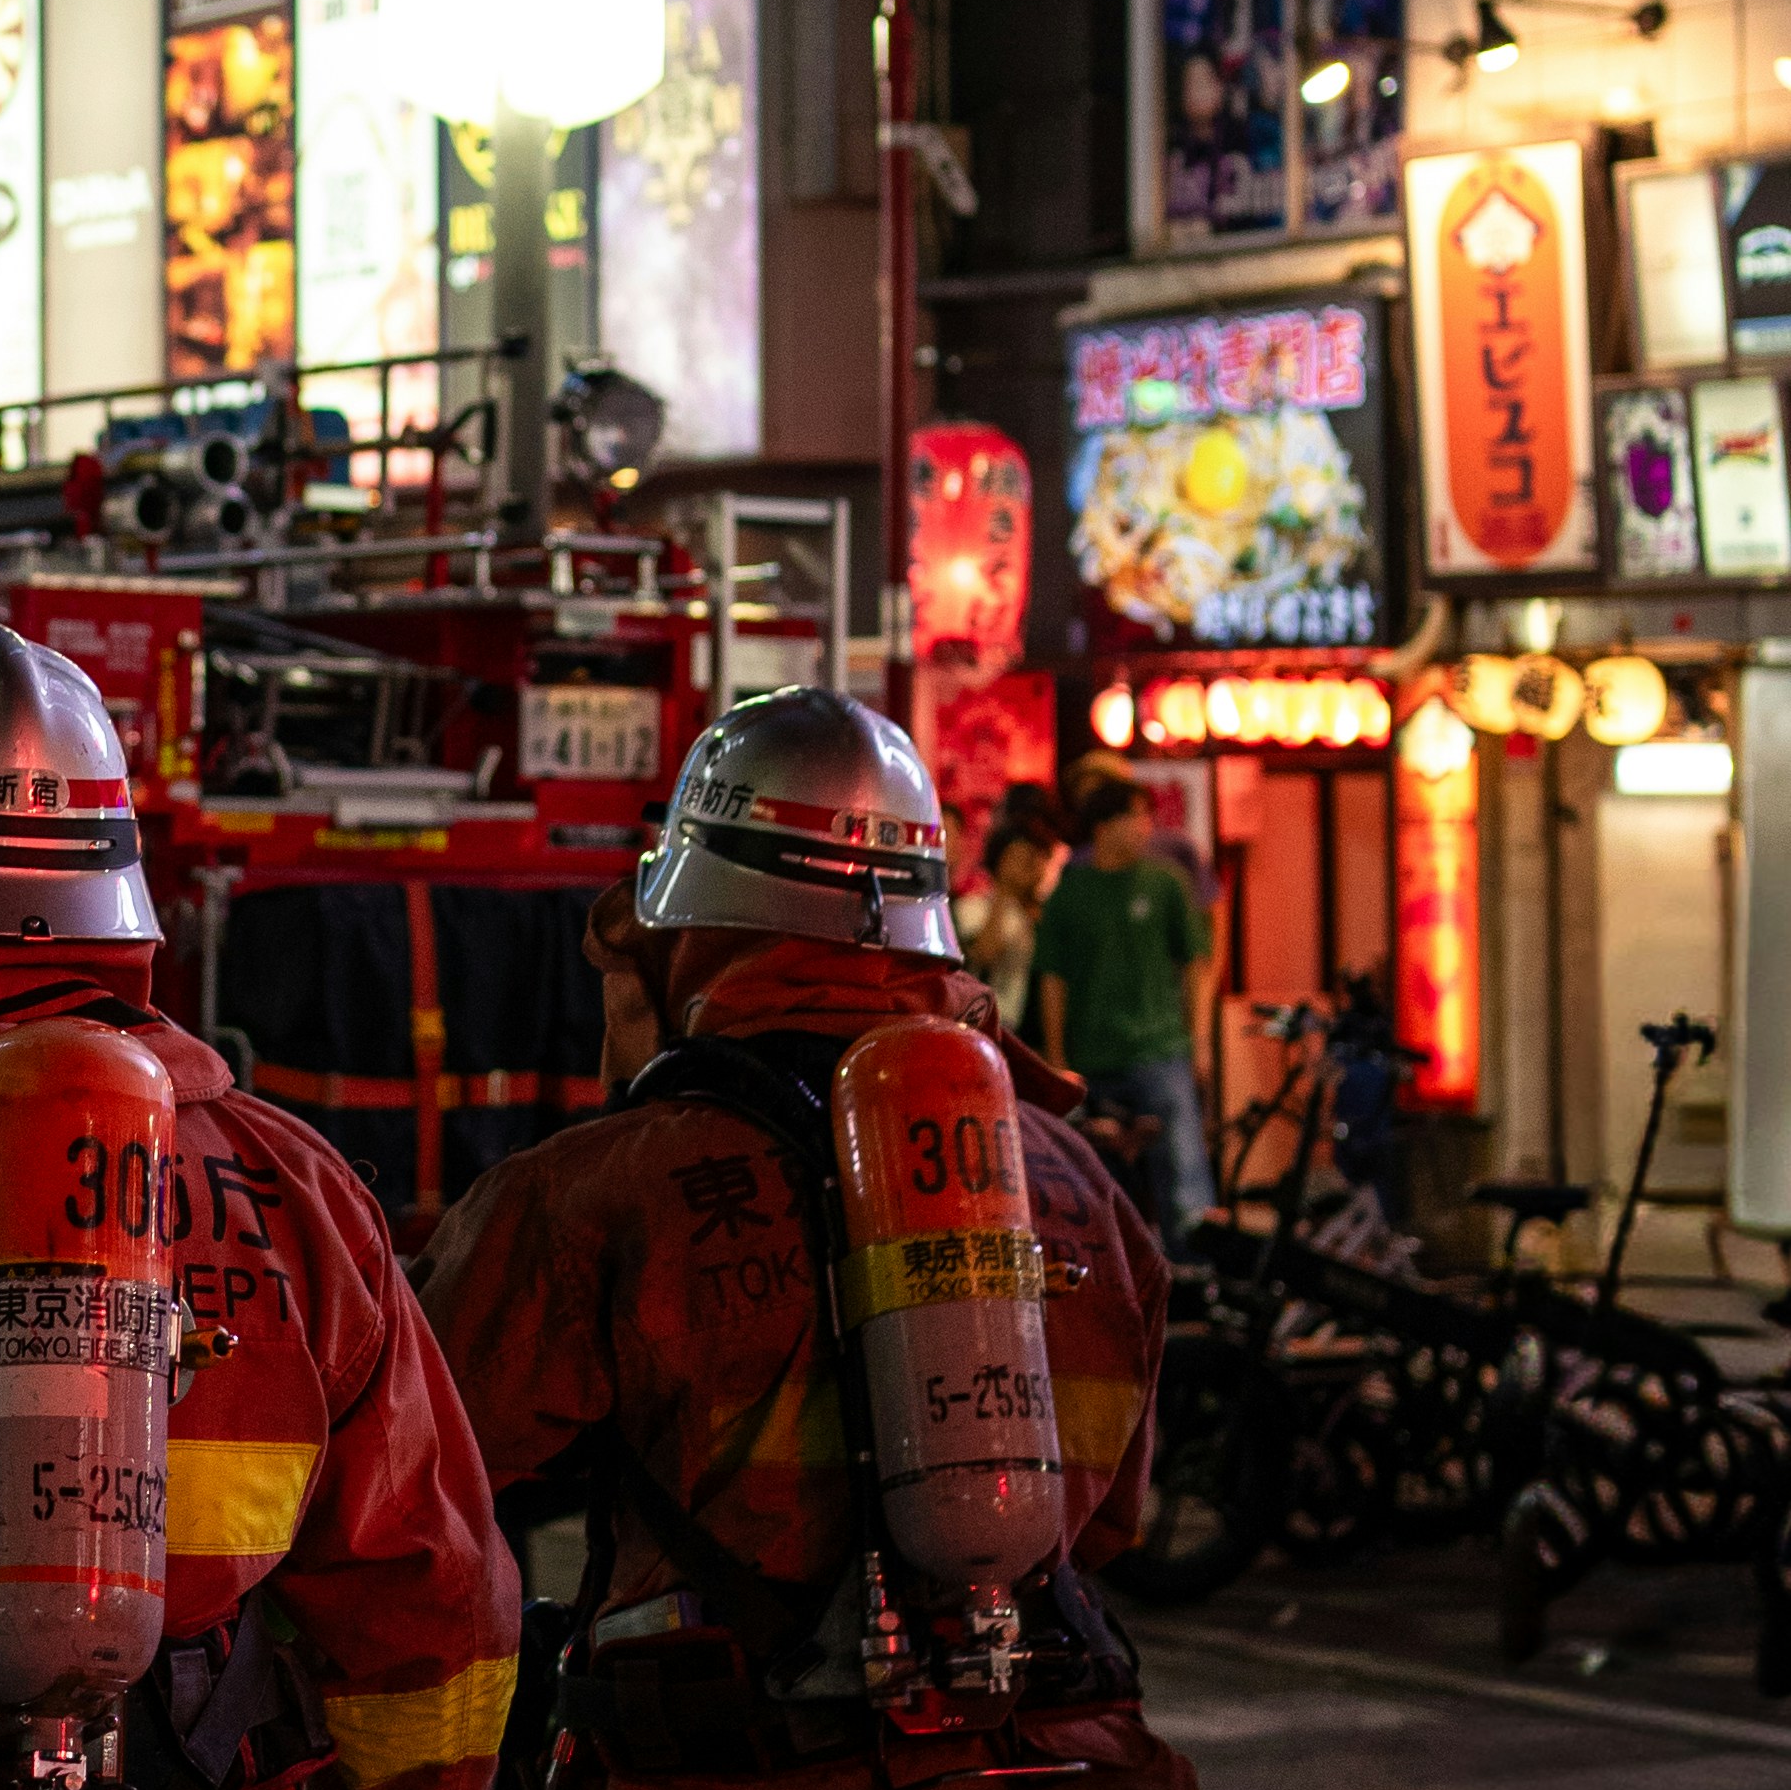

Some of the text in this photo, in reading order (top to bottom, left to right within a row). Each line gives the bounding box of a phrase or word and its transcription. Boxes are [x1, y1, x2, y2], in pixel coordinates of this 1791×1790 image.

[182, 1262, 291, 1323] EPT
[697, 1243, 811, 1309] TOK
[77, 1336, 123, 1361] FIRE
